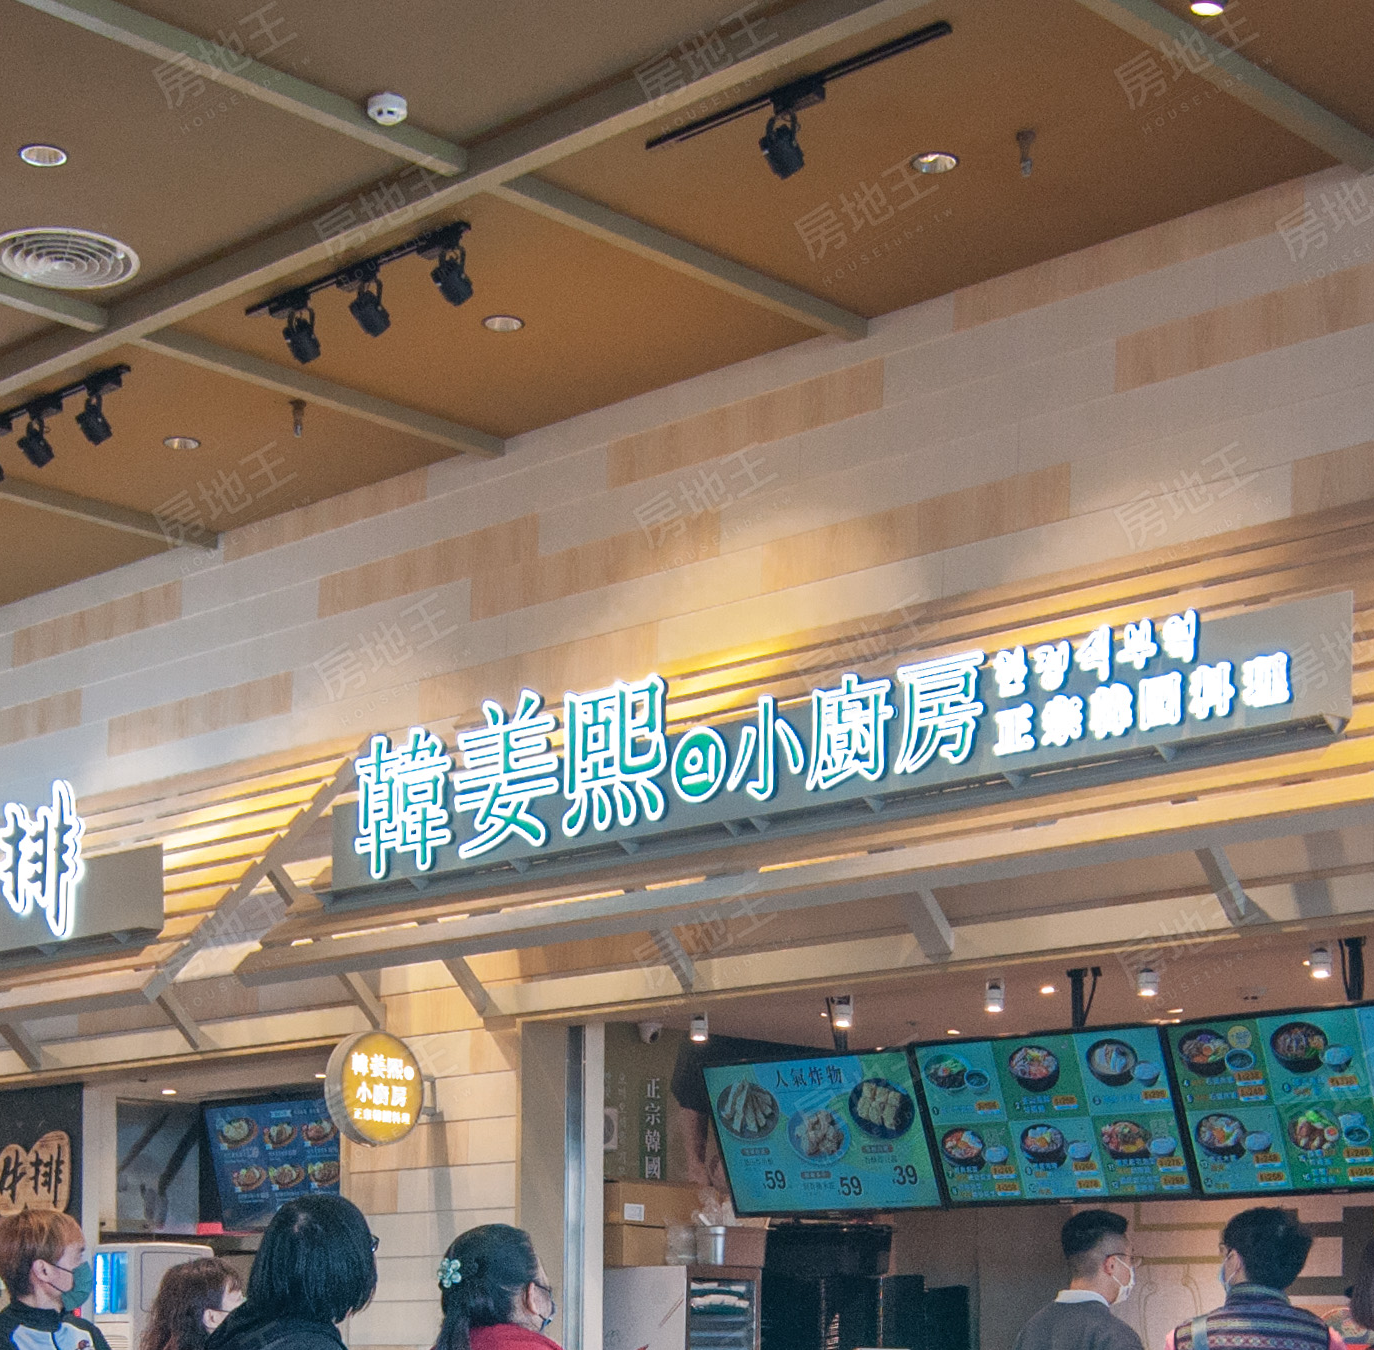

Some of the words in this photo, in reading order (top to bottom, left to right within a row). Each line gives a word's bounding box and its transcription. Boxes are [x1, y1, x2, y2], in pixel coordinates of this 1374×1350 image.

[774, 1064, 844, 1089] 人氣炸物
[644, 1077, 661, 1180] 正宗韓國
